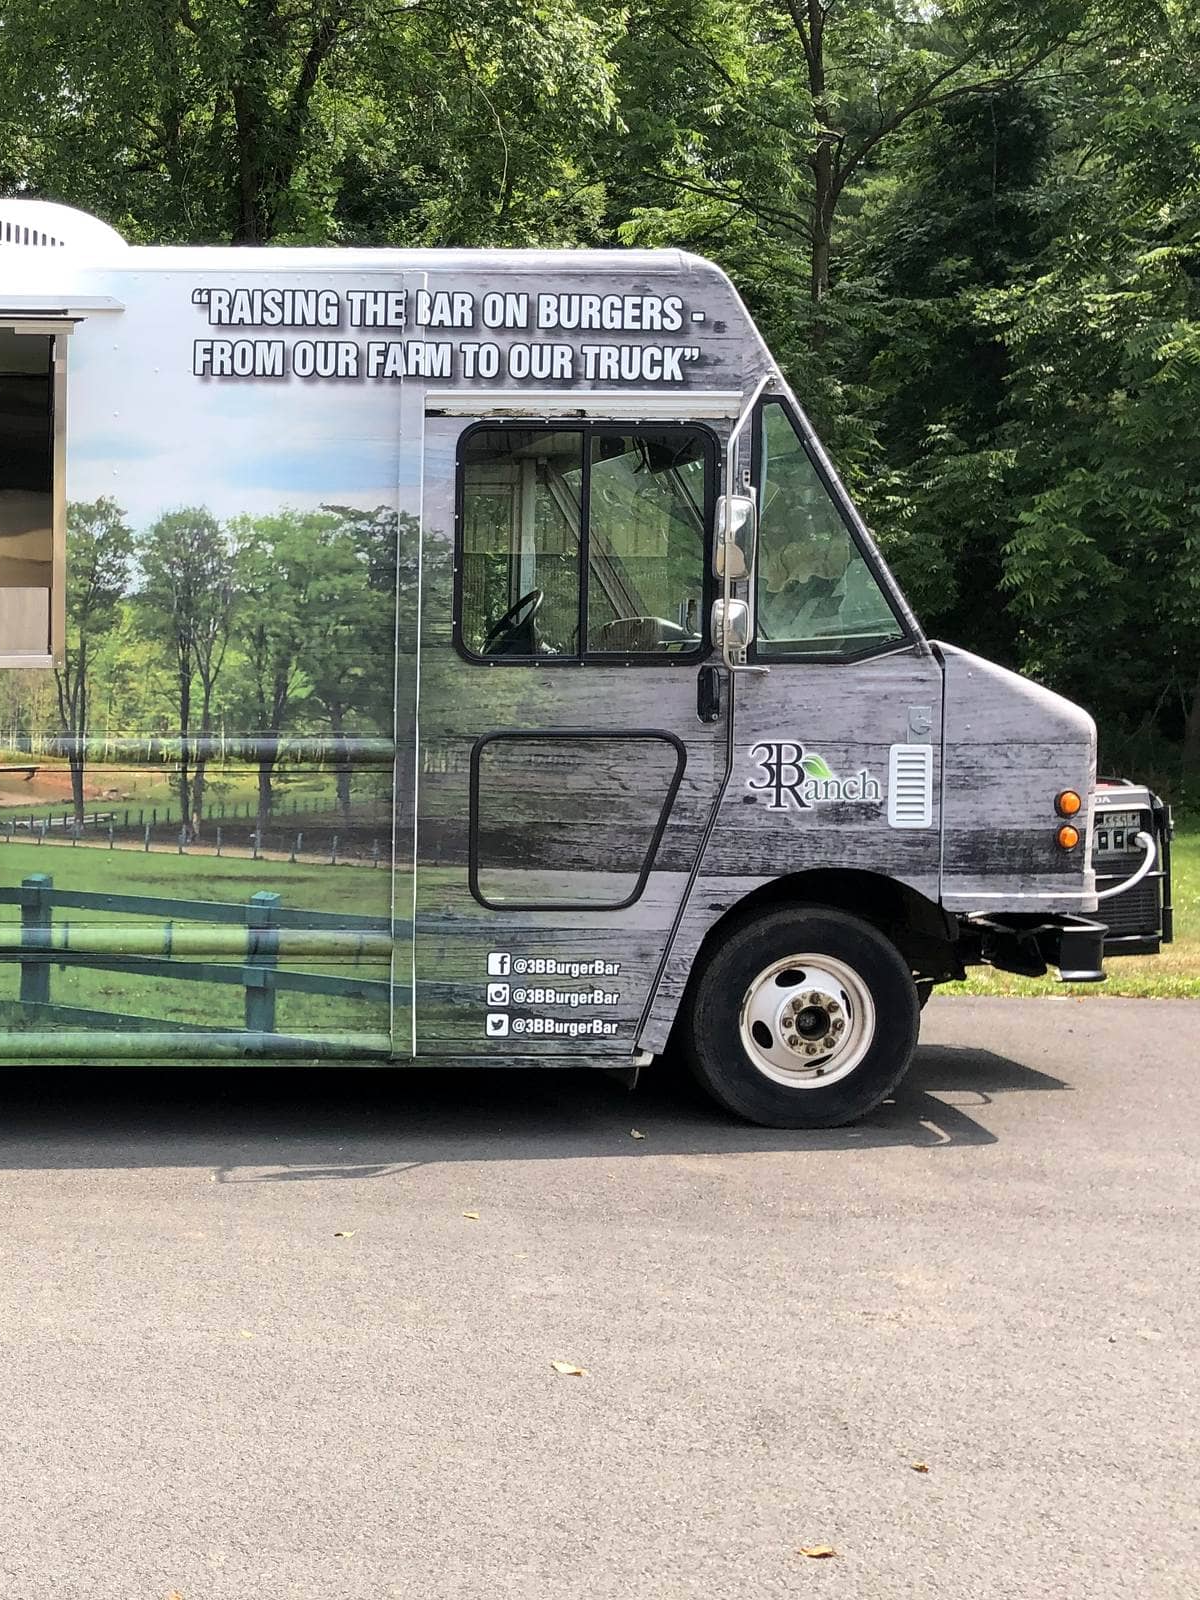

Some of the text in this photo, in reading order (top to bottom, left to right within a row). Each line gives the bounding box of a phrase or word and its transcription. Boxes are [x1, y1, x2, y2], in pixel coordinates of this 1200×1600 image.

[191, 288, 340, 327] “RAISING
[347, 289, 407, 328] THE
[416, 289, 475, 329] BAR
[483, 291, 529, 329] ON
[537, 293, 684, 332] BURGERS
[193, 339, 700, 382] FROM OUR FARM TO OUR TRUCK”
[513, 958, 621, 977] @3BBurgerBar
[512, 988, 620, 1007] @3BBurgerBar
[511, 1017, 618, 1036] @3BBurgerBar
